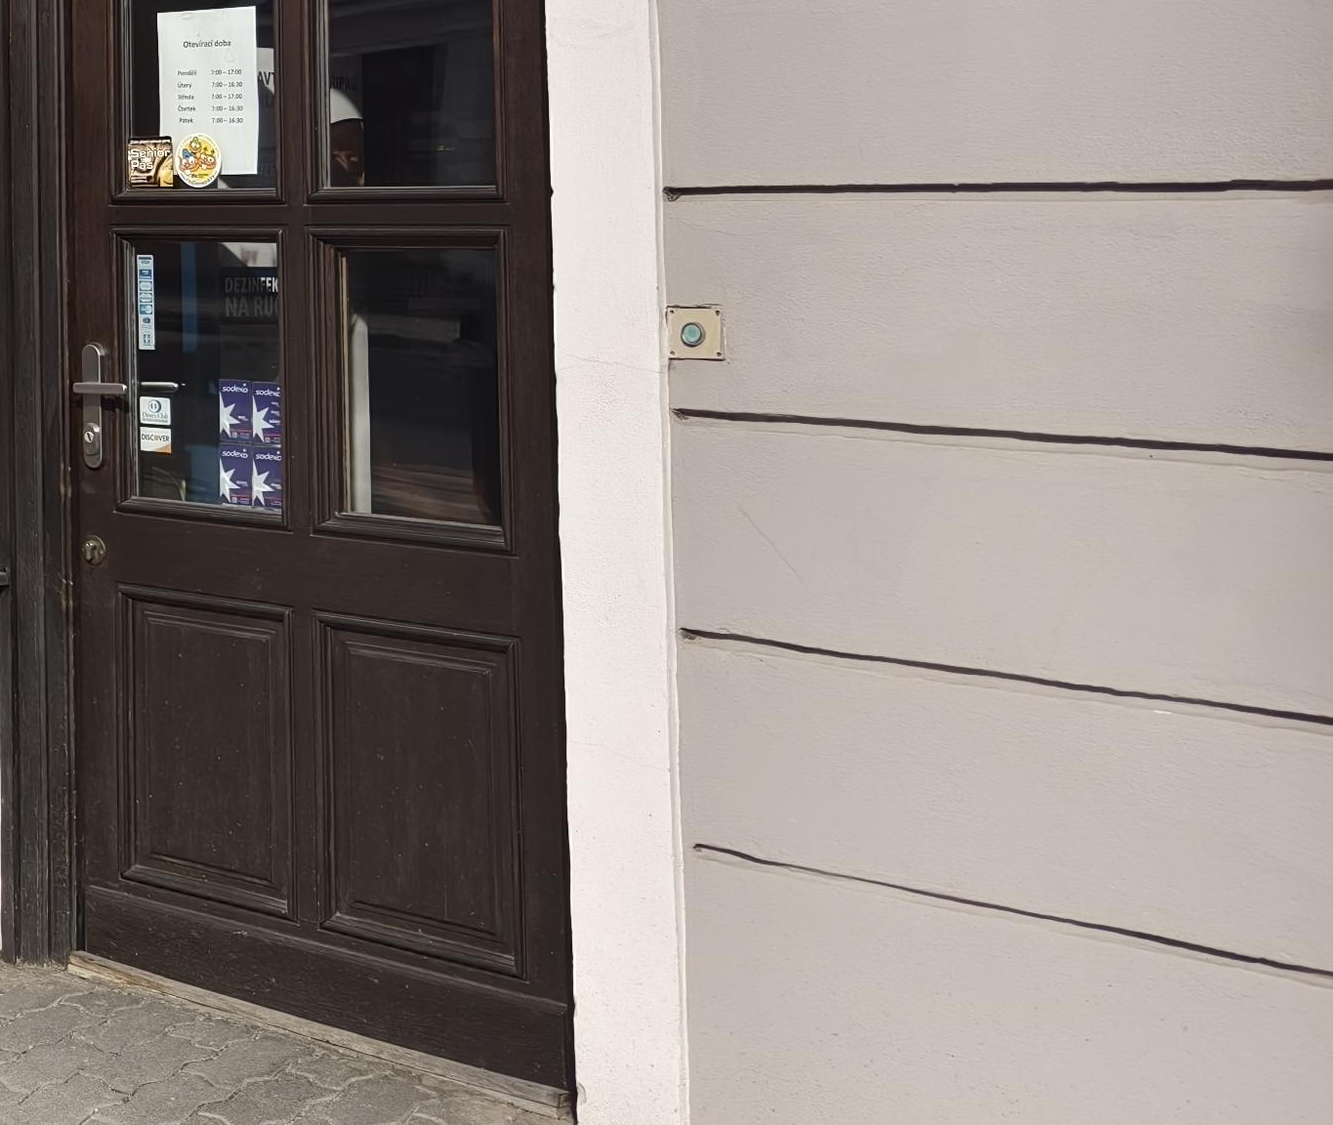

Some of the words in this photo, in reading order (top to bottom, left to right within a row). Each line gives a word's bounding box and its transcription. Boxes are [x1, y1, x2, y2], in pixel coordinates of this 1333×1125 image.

[182, 39, 213, 48] Otevírací
[214, 39, 232, 48] doba
[130, 148, 171, 158] Senior
[130, 160, 153, 170] Pas
[222, 383, 249, 394] sodexo
[141, 433, 170, 442] DISCOVER
[222, 449, 249, 459] sodexo
